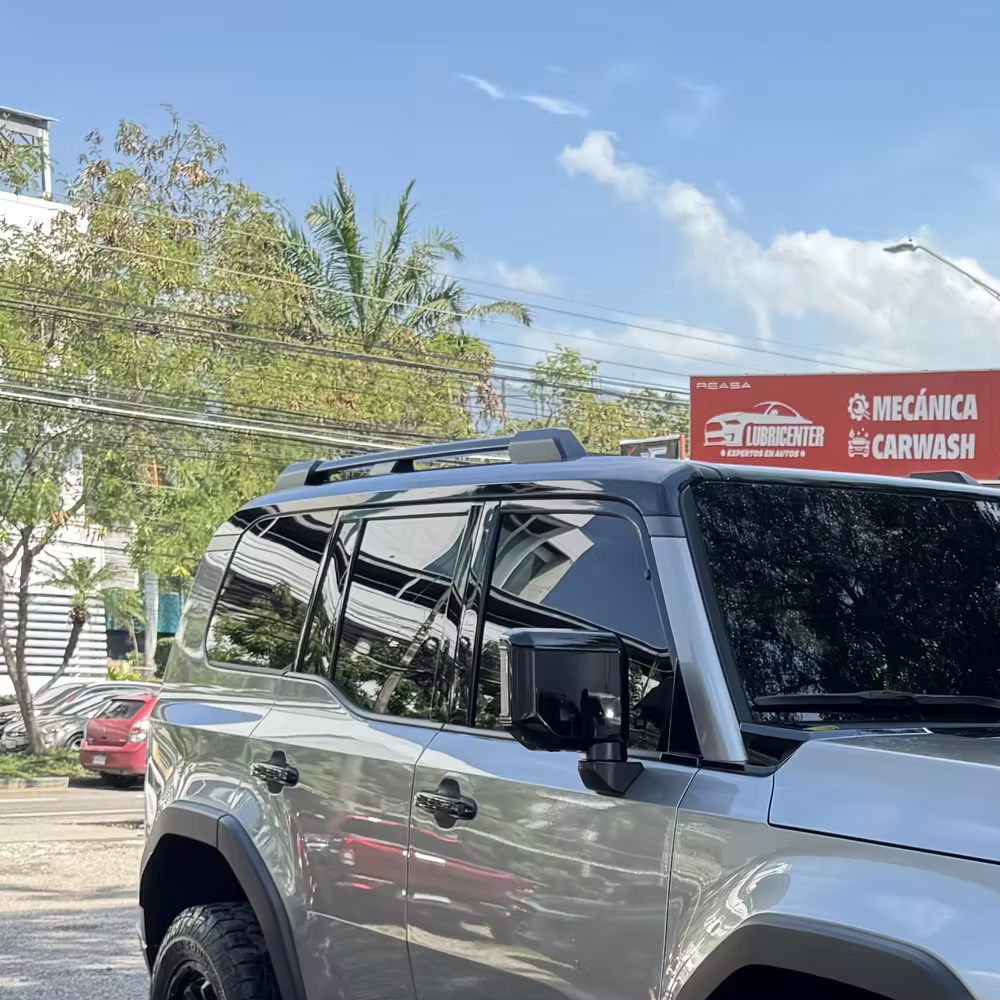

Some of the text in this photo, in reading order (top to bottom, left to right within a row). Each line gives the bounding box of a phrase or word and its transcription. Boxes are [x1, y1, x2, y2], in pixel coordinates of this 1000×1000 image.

[872, 388, 978, 421] MECÁNICA
[745, 425, 825, 447] LUBRICENTER
[872, 433, 976, 460] CARWASH
[726, 449, 799, 458] EXPERTOS EN AUTOS
